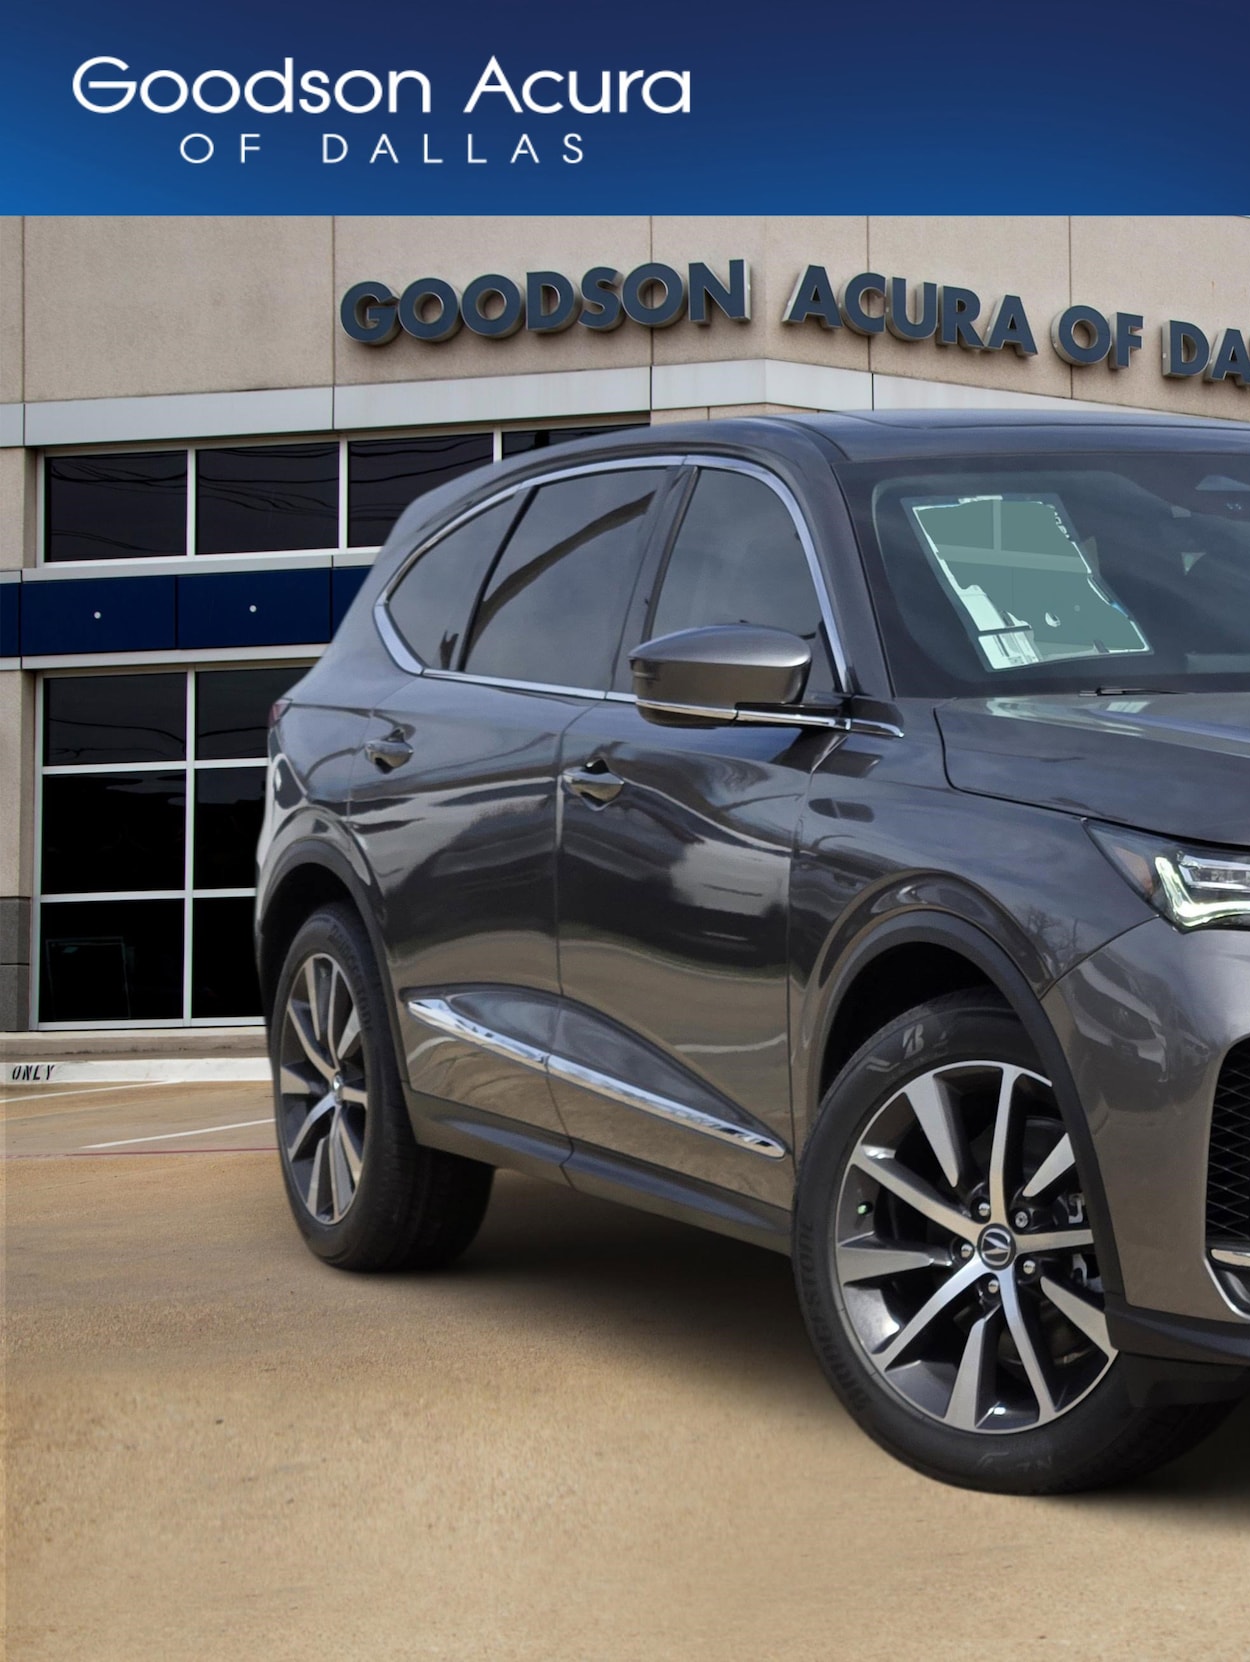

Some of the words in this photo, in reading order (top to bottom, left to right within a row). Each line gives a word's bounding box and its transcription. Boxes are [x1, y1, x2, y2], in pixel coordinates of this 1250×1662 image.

[340, 259, 750, 346] GOODSON
[782, 264, 1038, 356] ACURA
[1051, 305, 1144, 370] OF
[12, 1064, 55, 1081] ONLY
